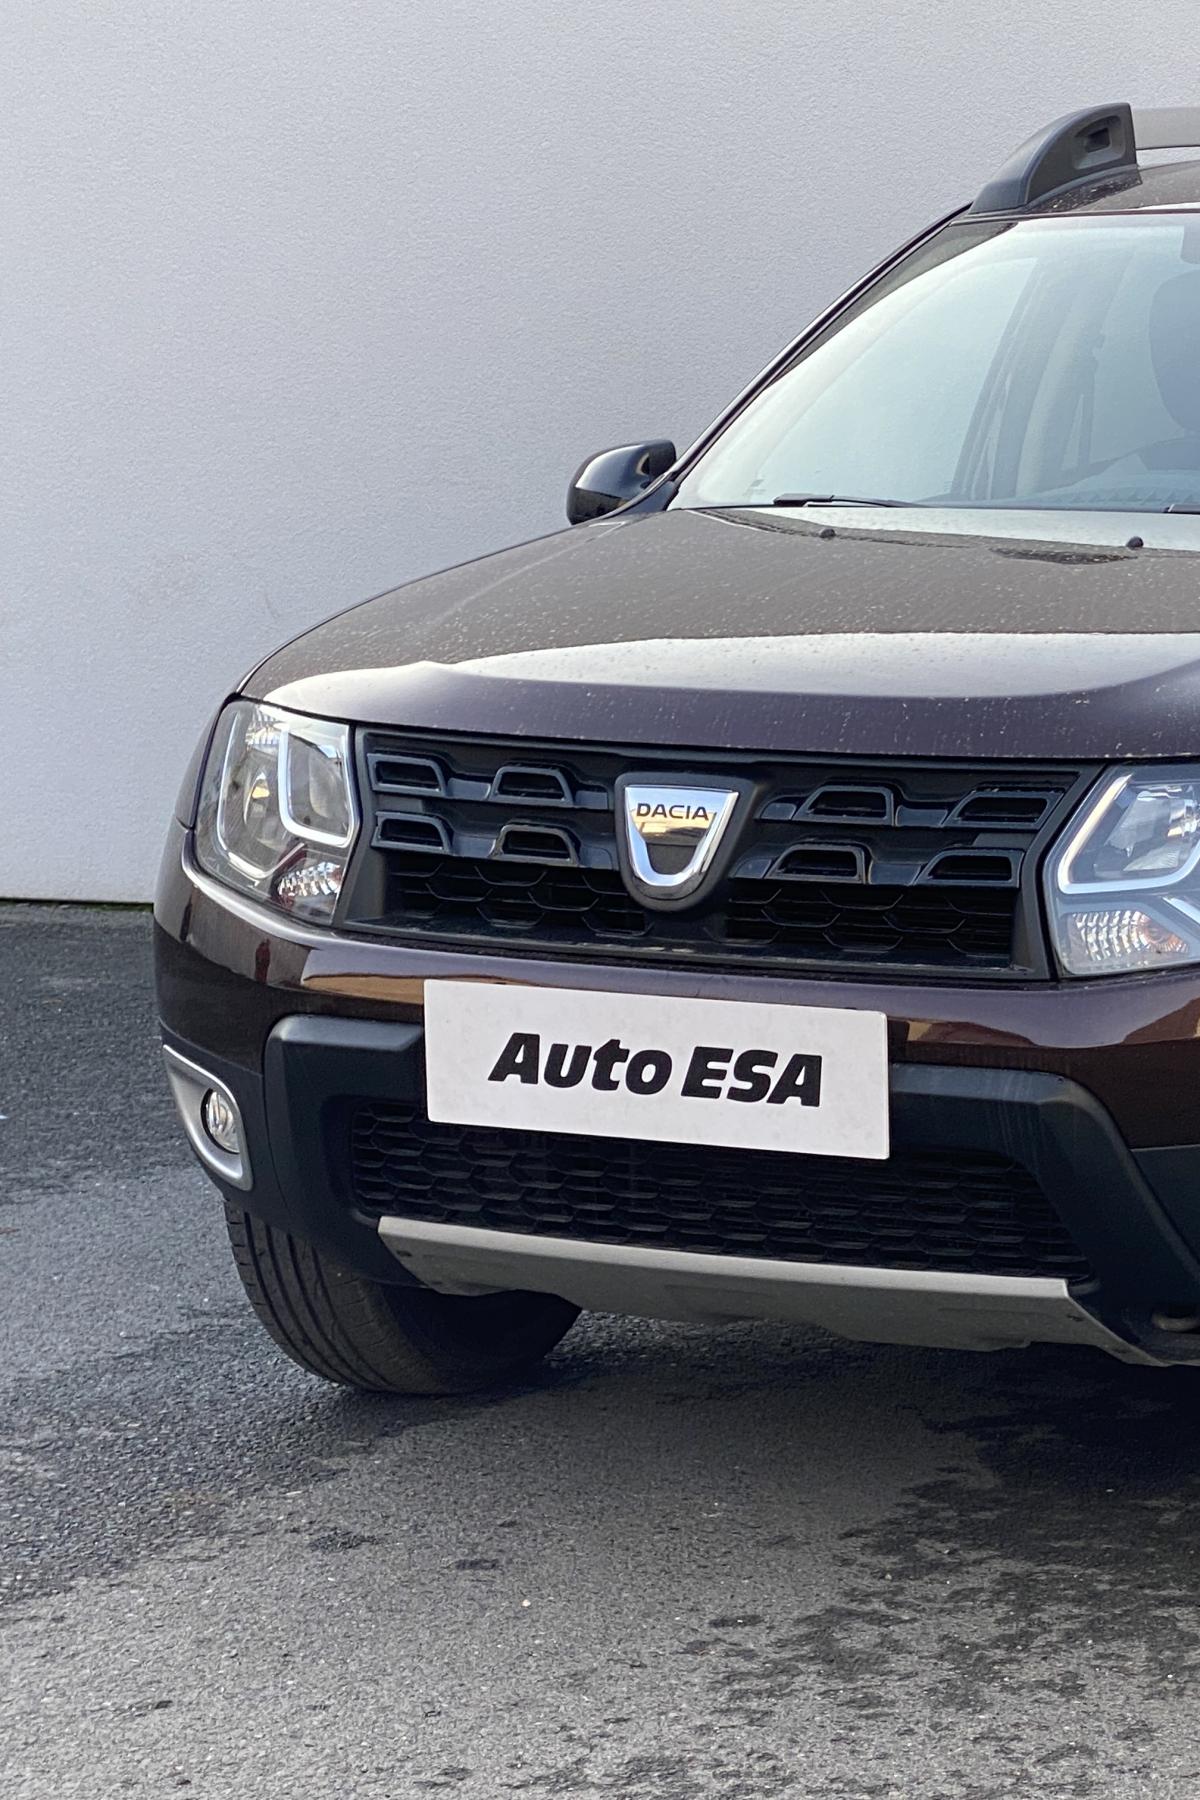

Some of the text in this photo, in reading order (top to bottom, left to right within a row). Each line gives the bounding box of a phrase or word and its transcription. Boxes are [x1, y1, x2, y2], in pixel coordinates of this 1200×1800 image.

[636, 803, 709, 821] DACIA
[488, 1032, 822, 1107] Auto ESA
